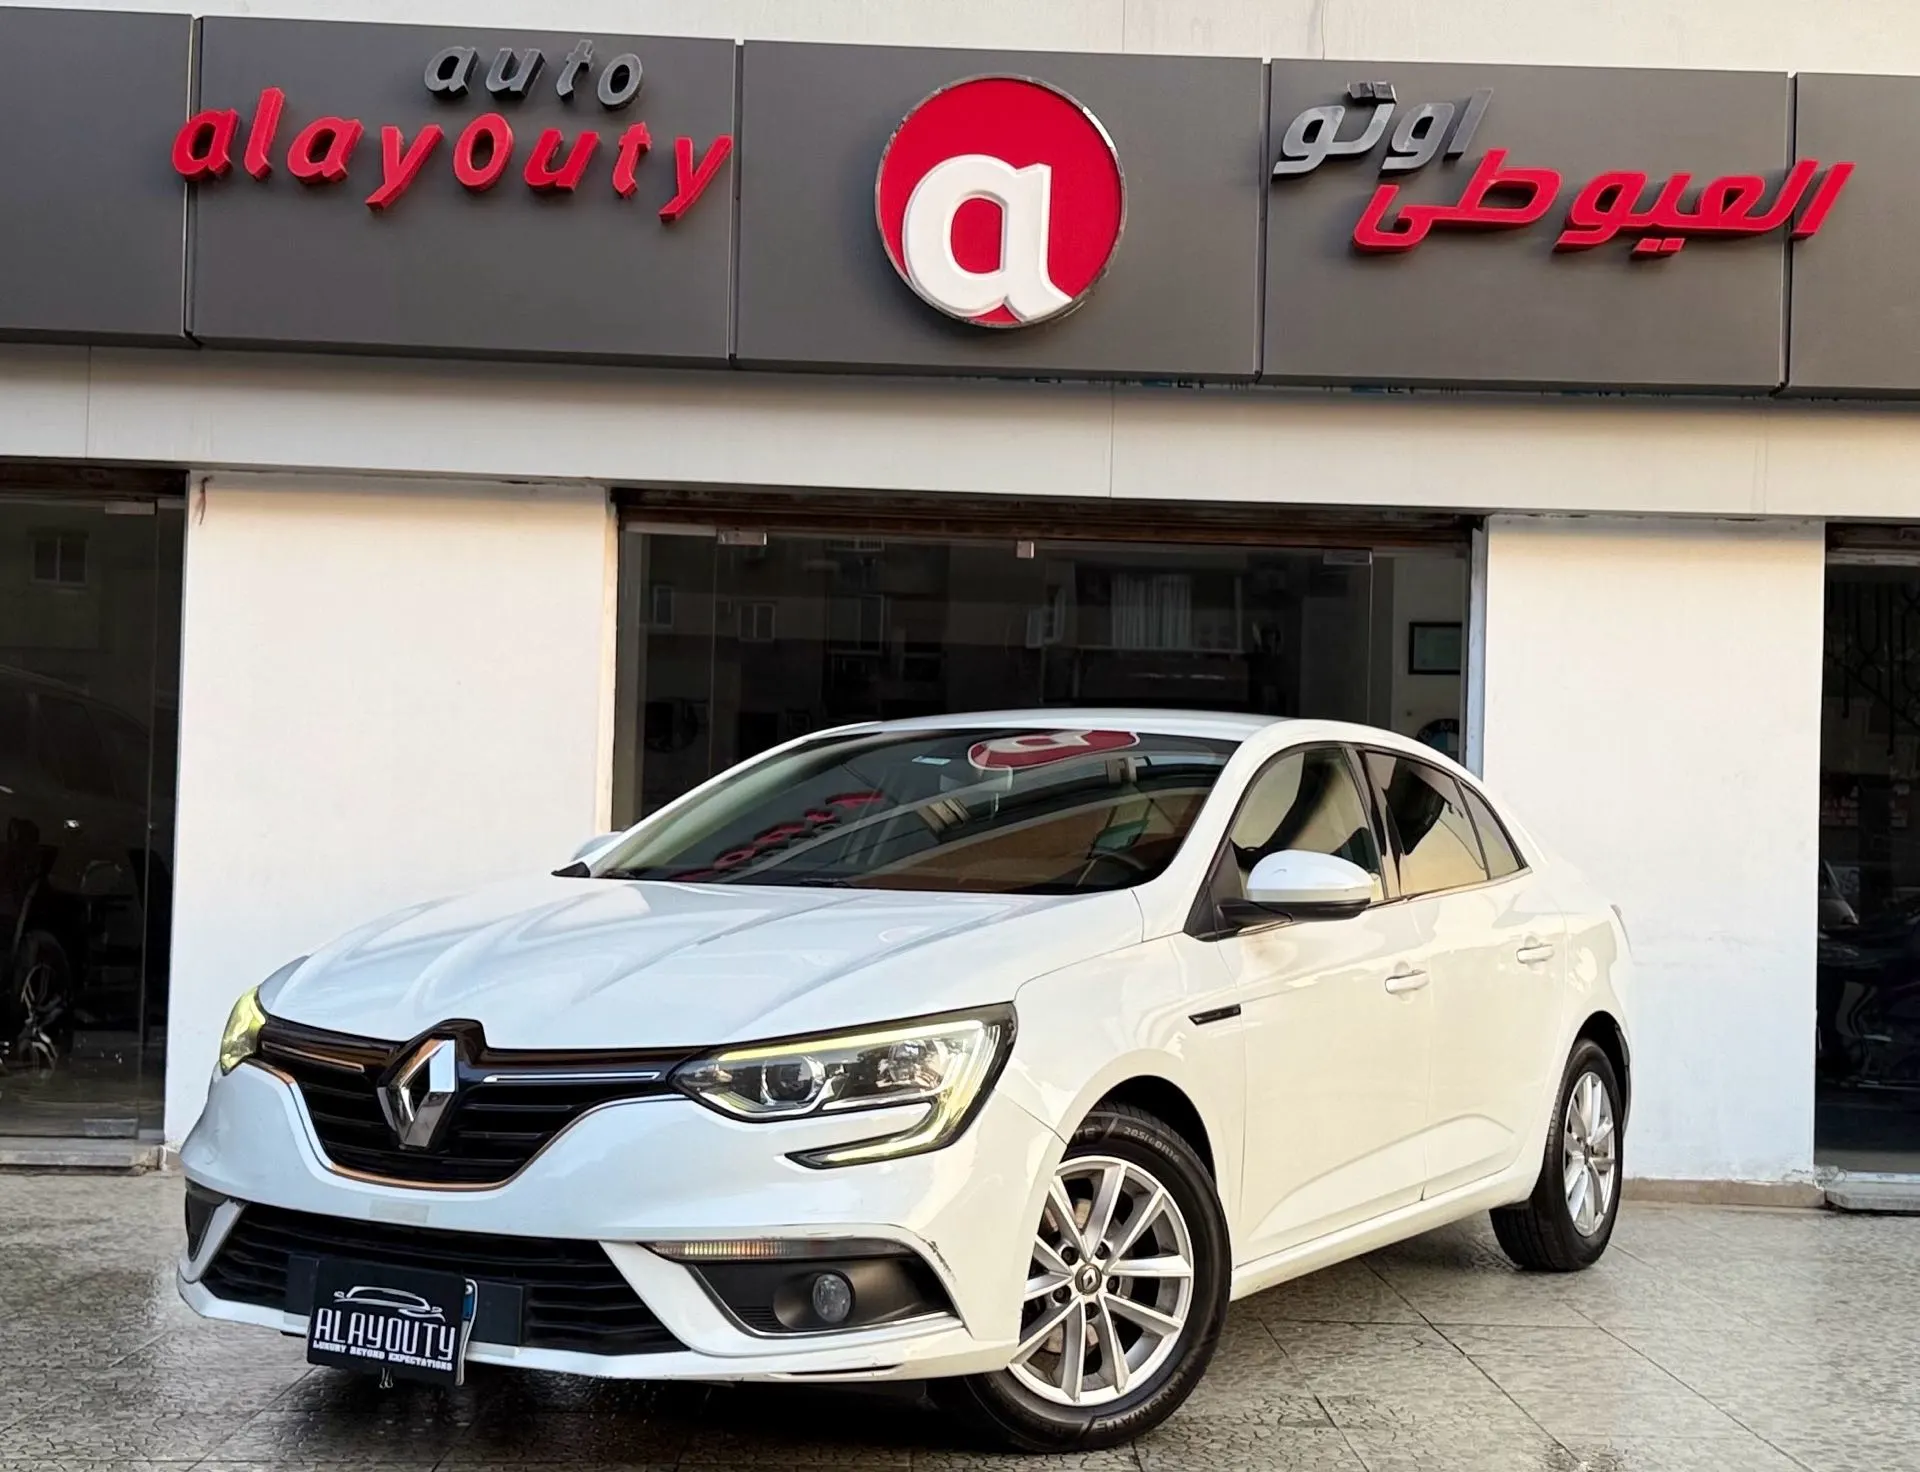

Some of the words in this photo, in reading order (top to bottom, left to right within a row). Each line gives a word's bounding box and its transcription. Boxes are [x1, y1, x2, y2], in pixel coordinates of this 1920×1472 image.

[424, 40, 644, 110] auto
[172, 87, 733, 222] alayouty
[1272, 81, 1493, 182] اوتو
[902, 153, 1073, 321] a
[312, 1340, 347, 1354] LUXURY
[349, 1346, 386, 1360] BEYOND
[388, 1352, 453, 1371] EXPECTATIONS
[314, 1308, 456, 1361] ALAYOUTY
